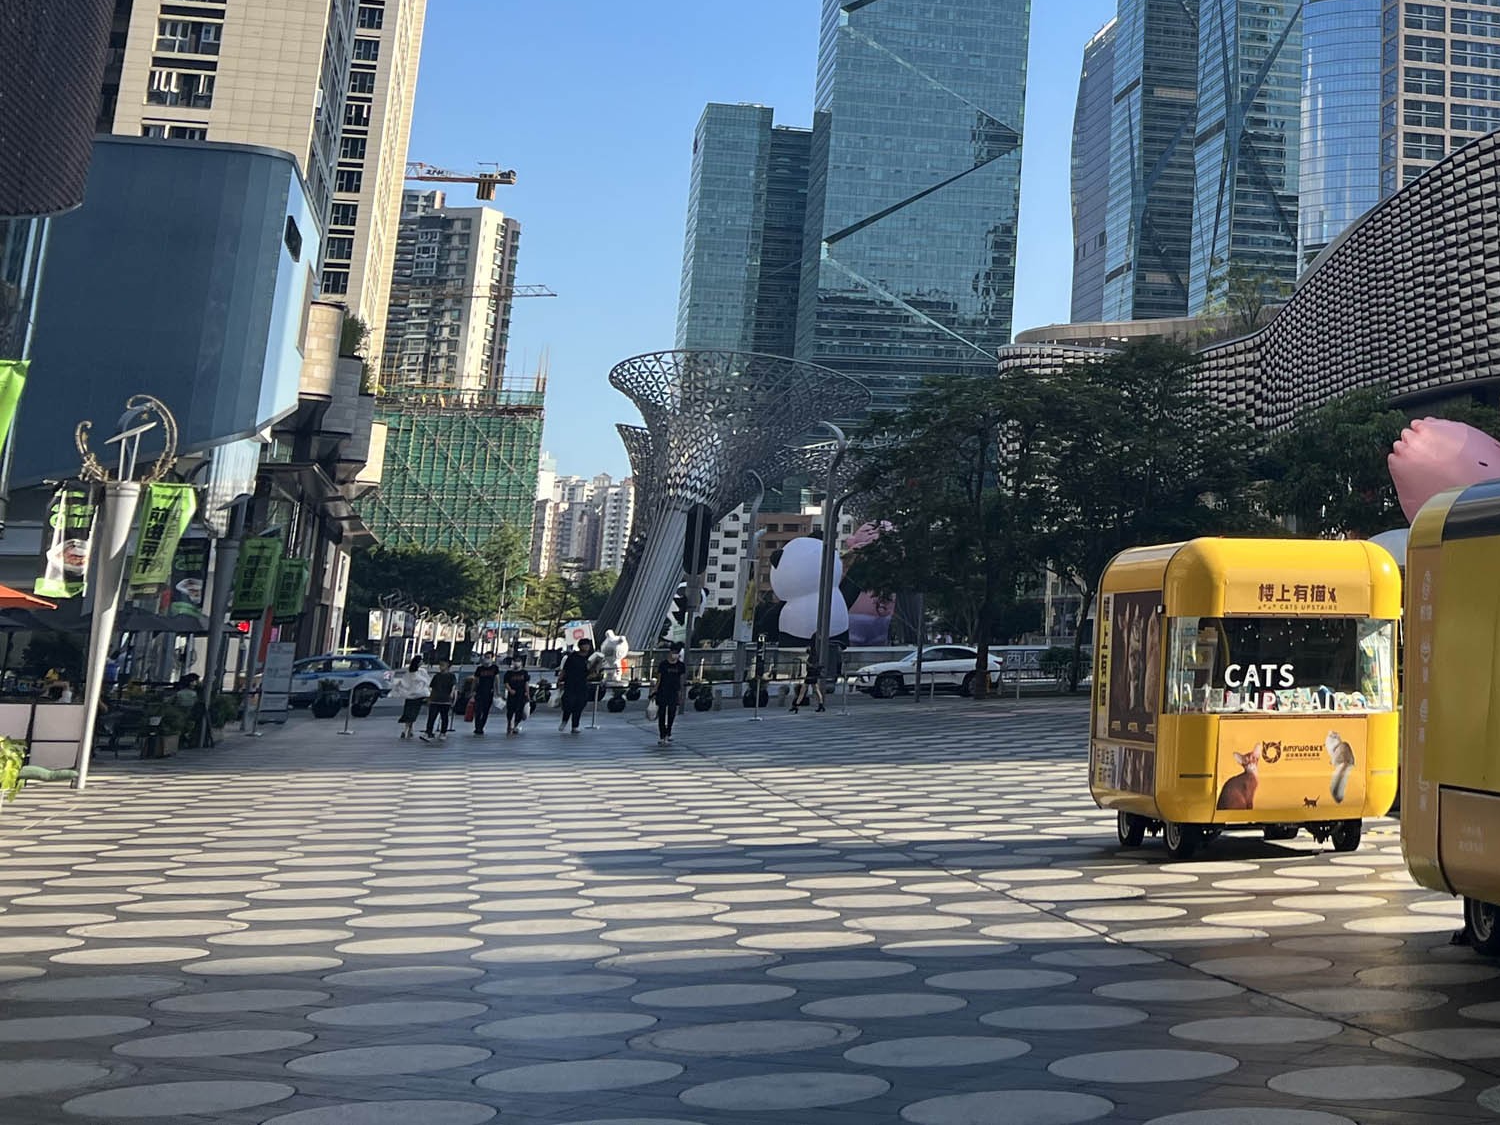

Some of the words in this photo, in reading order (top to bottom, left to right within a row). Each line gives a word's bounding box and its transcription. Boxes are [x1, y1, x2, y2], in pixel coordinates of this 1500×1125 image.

[1258, 583, 1327, 603] 楼上有猫
[1224, 663, 1295, 687] CATS
